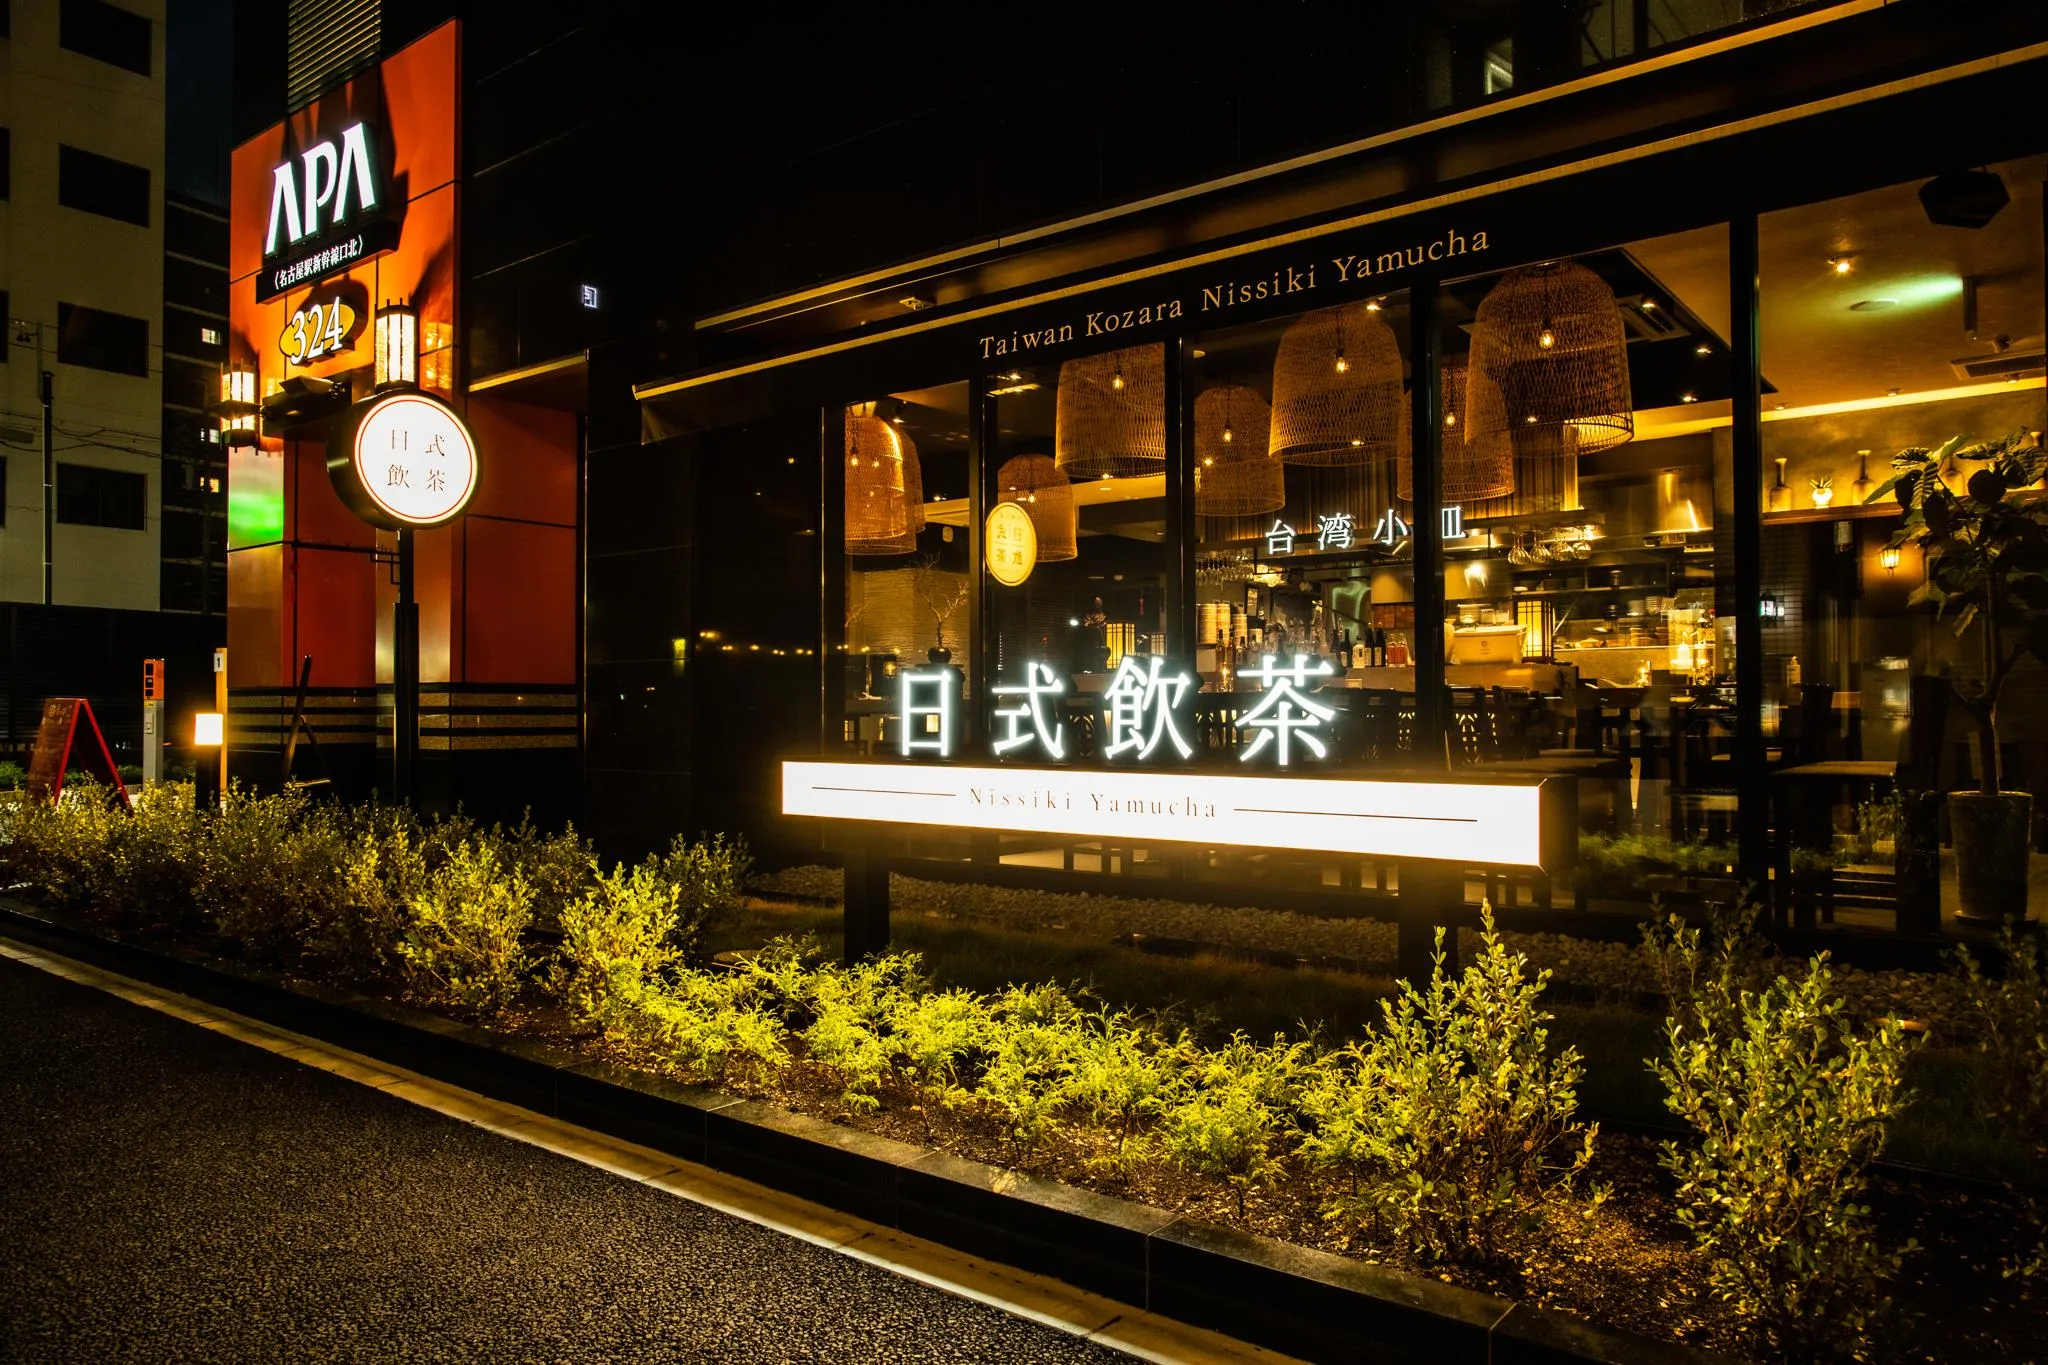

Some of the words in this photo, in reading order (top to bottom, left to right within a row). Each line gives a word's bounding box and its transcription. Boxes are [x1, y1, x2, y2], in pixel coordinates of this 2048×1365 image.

[266, 121, 376, 255] APA
[290, 296, 343, 365] 324
[980, 324, 1074, 359] Taiwan
[1085, 300, 1183, 337] Kozara
[1201, 264, 1316, 311] Nissiki
[1333, 229, 1489, 282] Yamucha
[1265, 505, 1467, 555] 台湾小皿
[899, 655, 1336, 766] 日式飲茶
[970, 788, 1071, 810] Nissiki
[1091, 793, 1217, 819] Yamucha
